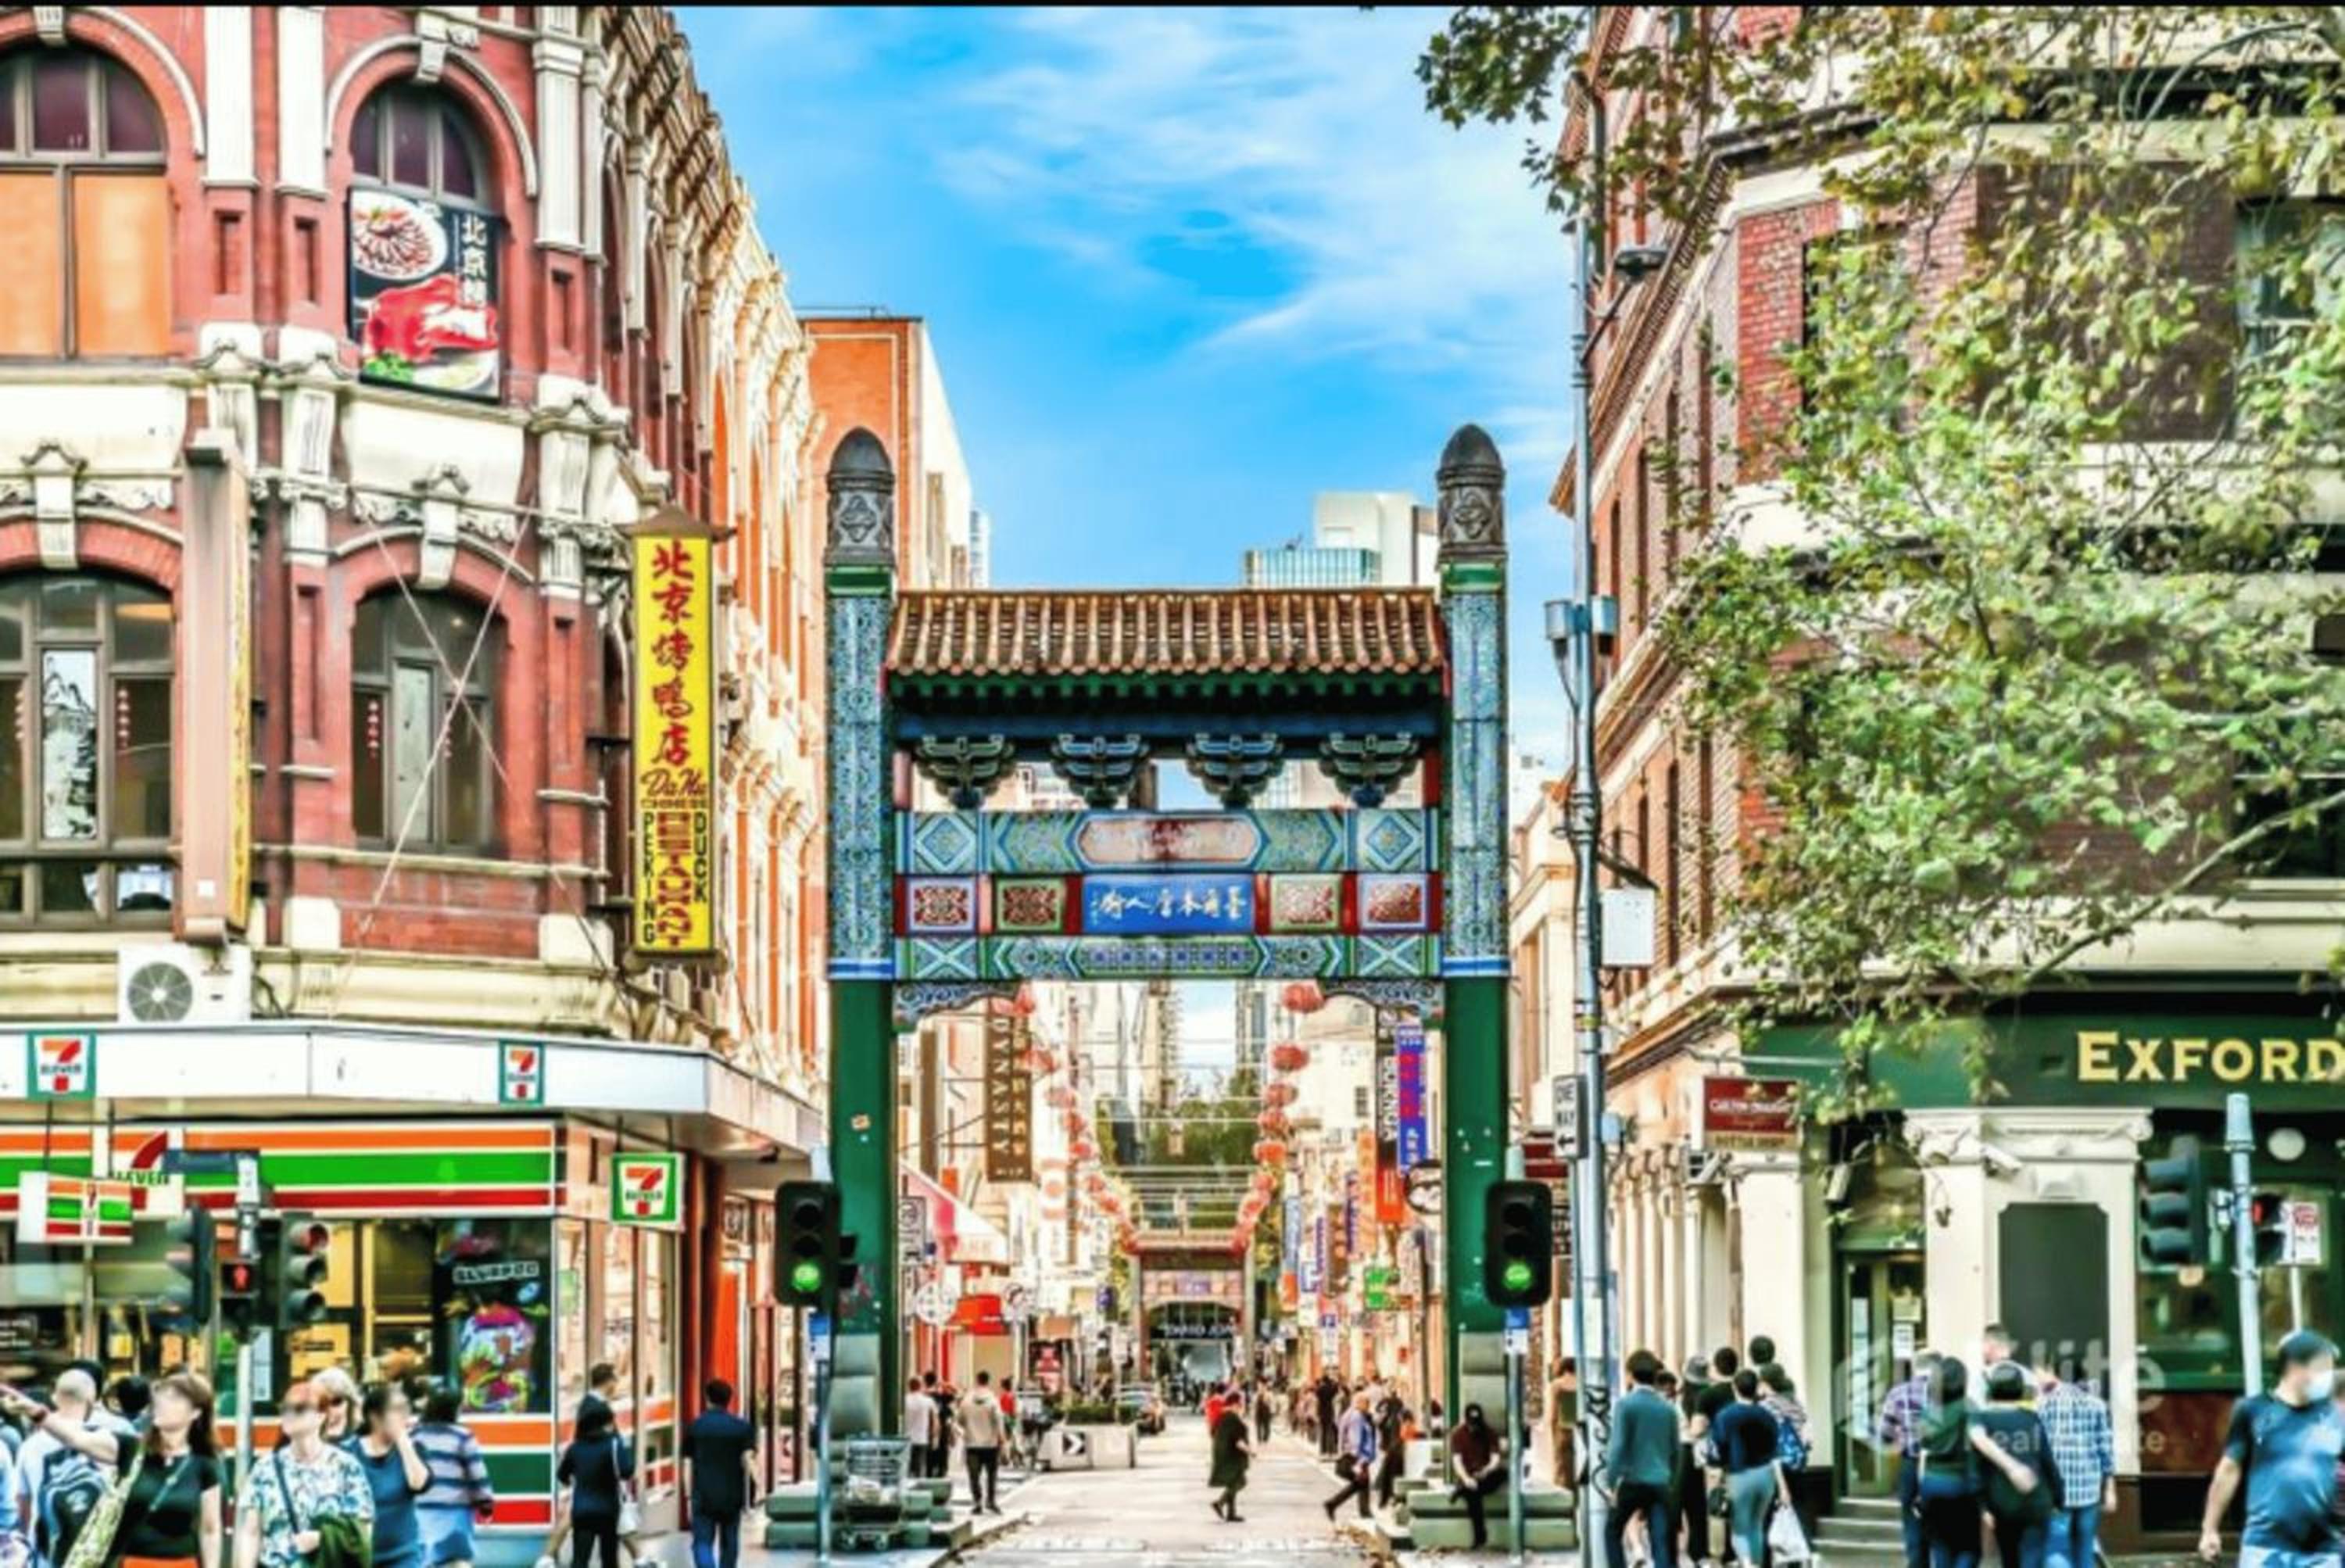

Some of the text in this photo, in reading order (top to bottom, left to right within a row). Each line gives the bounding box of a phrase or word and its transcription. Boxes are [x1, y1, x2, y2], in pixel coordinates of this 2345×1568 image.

[643, 812, 655, 944] PEKING
[693, 812, 707, 903] DUCK
[991, 1017, 1010, 1153] DYNASTY
